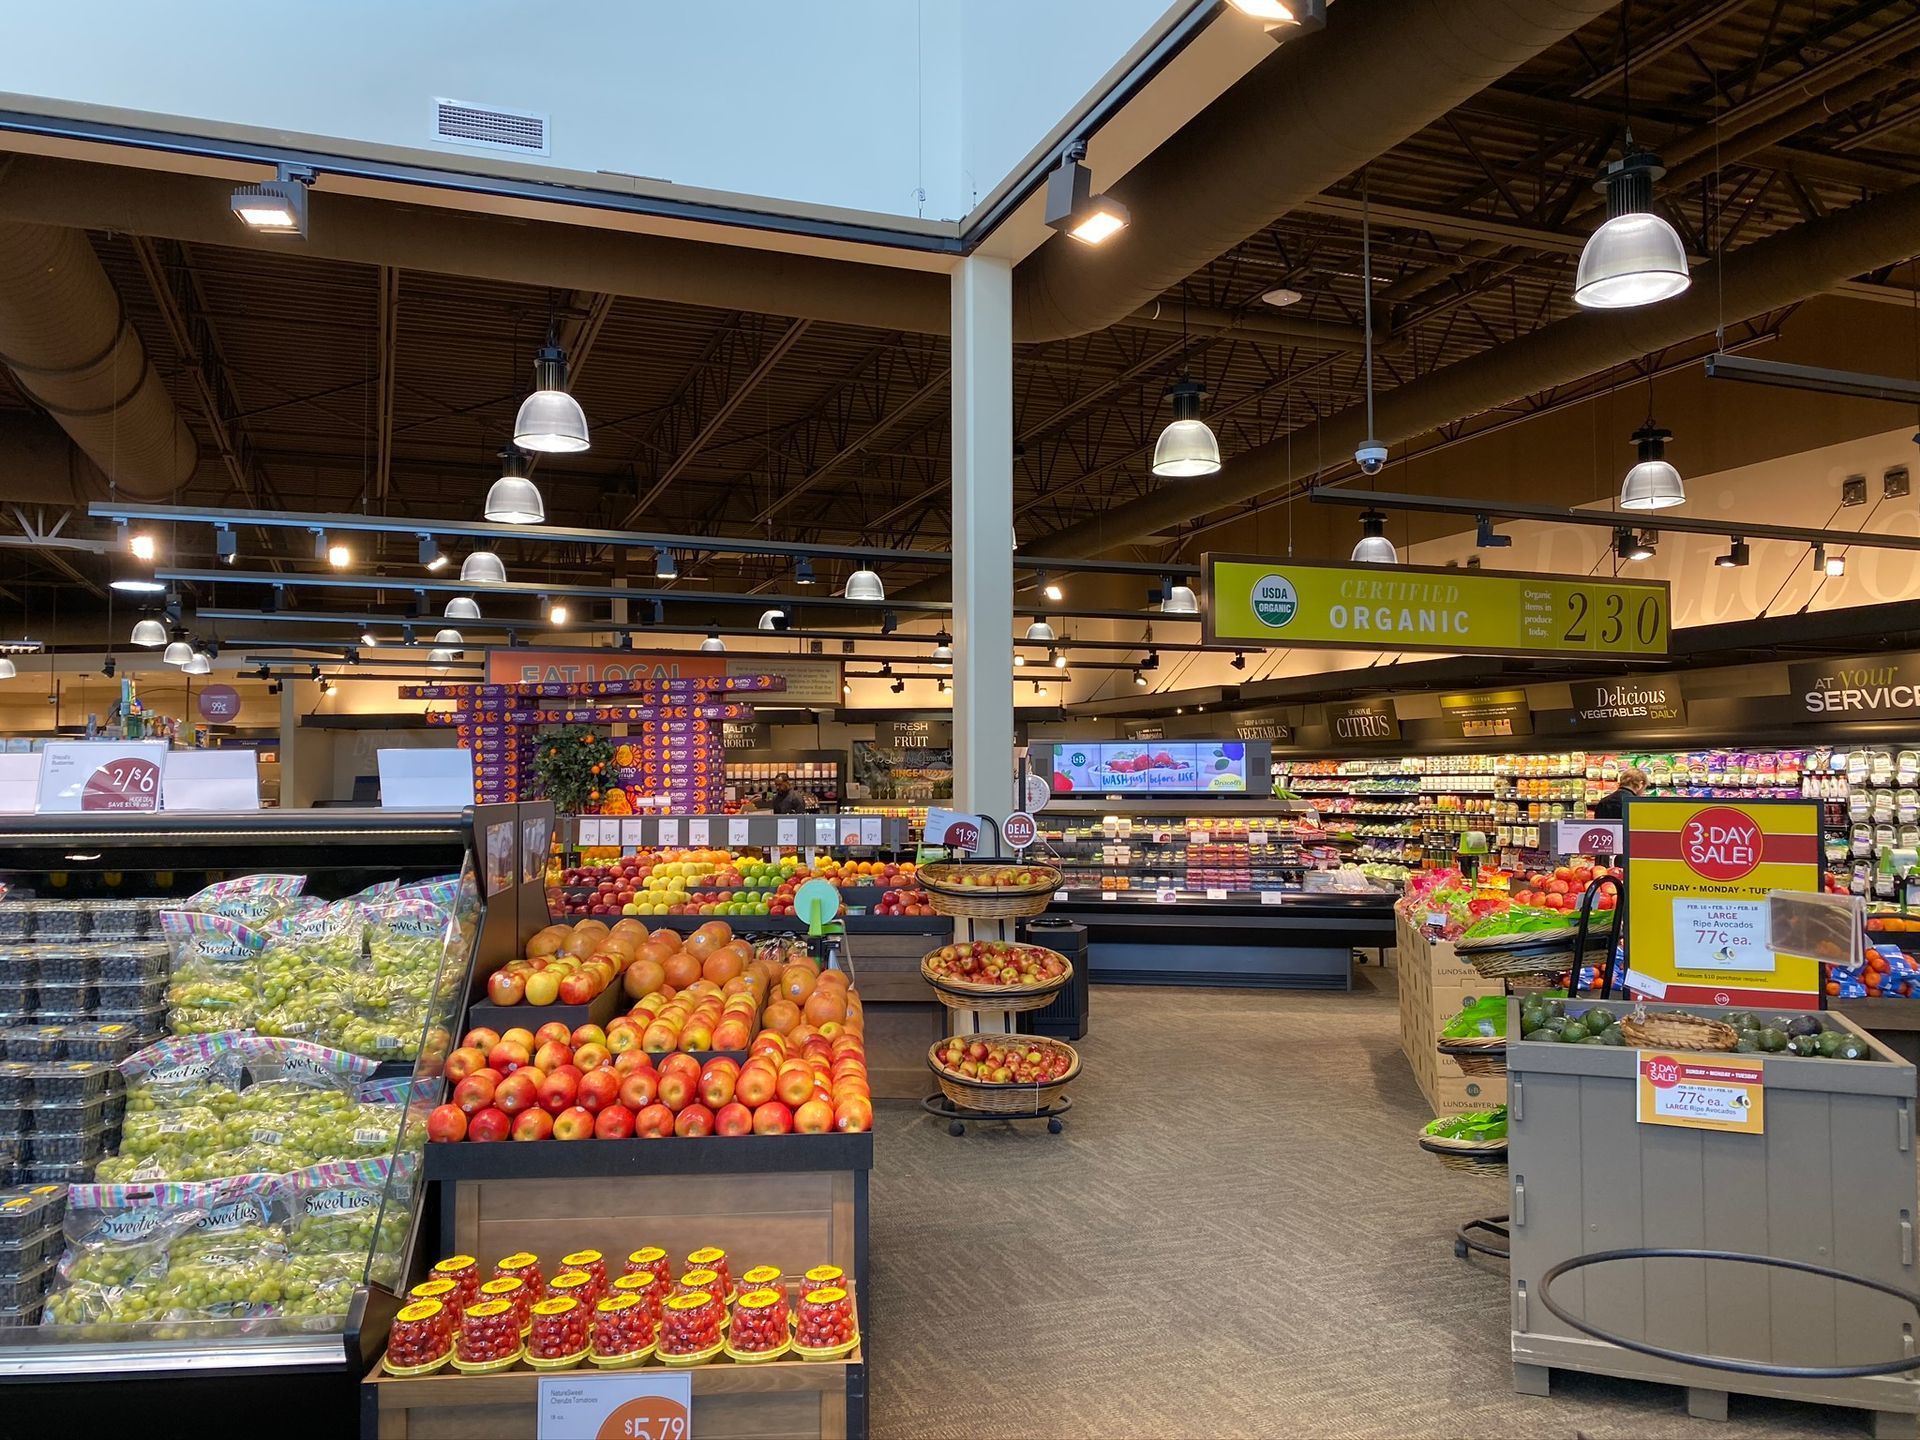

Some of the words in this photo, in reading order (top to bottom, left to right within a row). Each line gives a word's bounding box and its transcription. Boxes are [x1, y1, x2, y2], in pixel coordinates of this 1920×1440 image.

[1262, 587, 1288, 599] USDA
[1340, 579, 1460, 604] CERTIFIED
[1524, 590, 1552, 600] Organic
[1258, 603, 1292, 613] ORGANIC
[1525, 603, 1543, 612] items
[1544, 604, 1552, 612] in
[1329, 605, 1470, 633] ORGANIC
[1524, 615, 1552, 625] produce
[1528, 627, 1549, 637] today.
[1814, 677, 1834, 689] AT
[1838, 666, 1898, 699] your
[1596, 686, 1666, 708] Delicious
[1580, 707, 1648, 719] VEGETABLES
[1650, 709, 1678, 719] DAILY
[723, 723, 756, 733] UALITY
[893, 722, 928, 731] FRESH
[1237, 725, 1288, 740] VEGETABLES
[1336, 715, 1390, 738] CITRUS
[894, 736, 929, 747] FRUIT
[112, 766, 154, 792] 2/$6
[1102, 774, 1128, 786] WASH
[1128, 773, 1146, 786] just
[1150, 773, 1175, 785] before
[1178, 771, 1199, 782] USE!
[1007, 823, 1031, 834] DEAL
[956, 827, 977, 843] $1.99
[1588, 834, 1613, 849] $2.99
[1690, 846, 1753, 866] SALE!
[1652, 883, 1690, 892] SUNDAY
[1700, 885, 1739, 894] MONDAY
[1693, 920, 1711, 928] Ripe
[1695, 930, 1728, 945] 77¢
[1732, 936, 1752, 945] ea.
[1650, 1072, 1677, 1082] SALE!
[1735, 1072, 1758, 1080] TUESDAY
[1677, 1091, 1705, 1104] 77¢
[1707, 1098, 1724, 1107] ea.
[1665, 1103, 1688, 1111] LARGE
[1689, 1105, 1704, 1113] Ripe
[1705, 1106, 1736, 1115] Avocados
[305, 1191, 370, 1215] Sweeties
[551, 1389, 583, 1397] NatureSweet
[624, 1417, 685, 1440] $5.79
